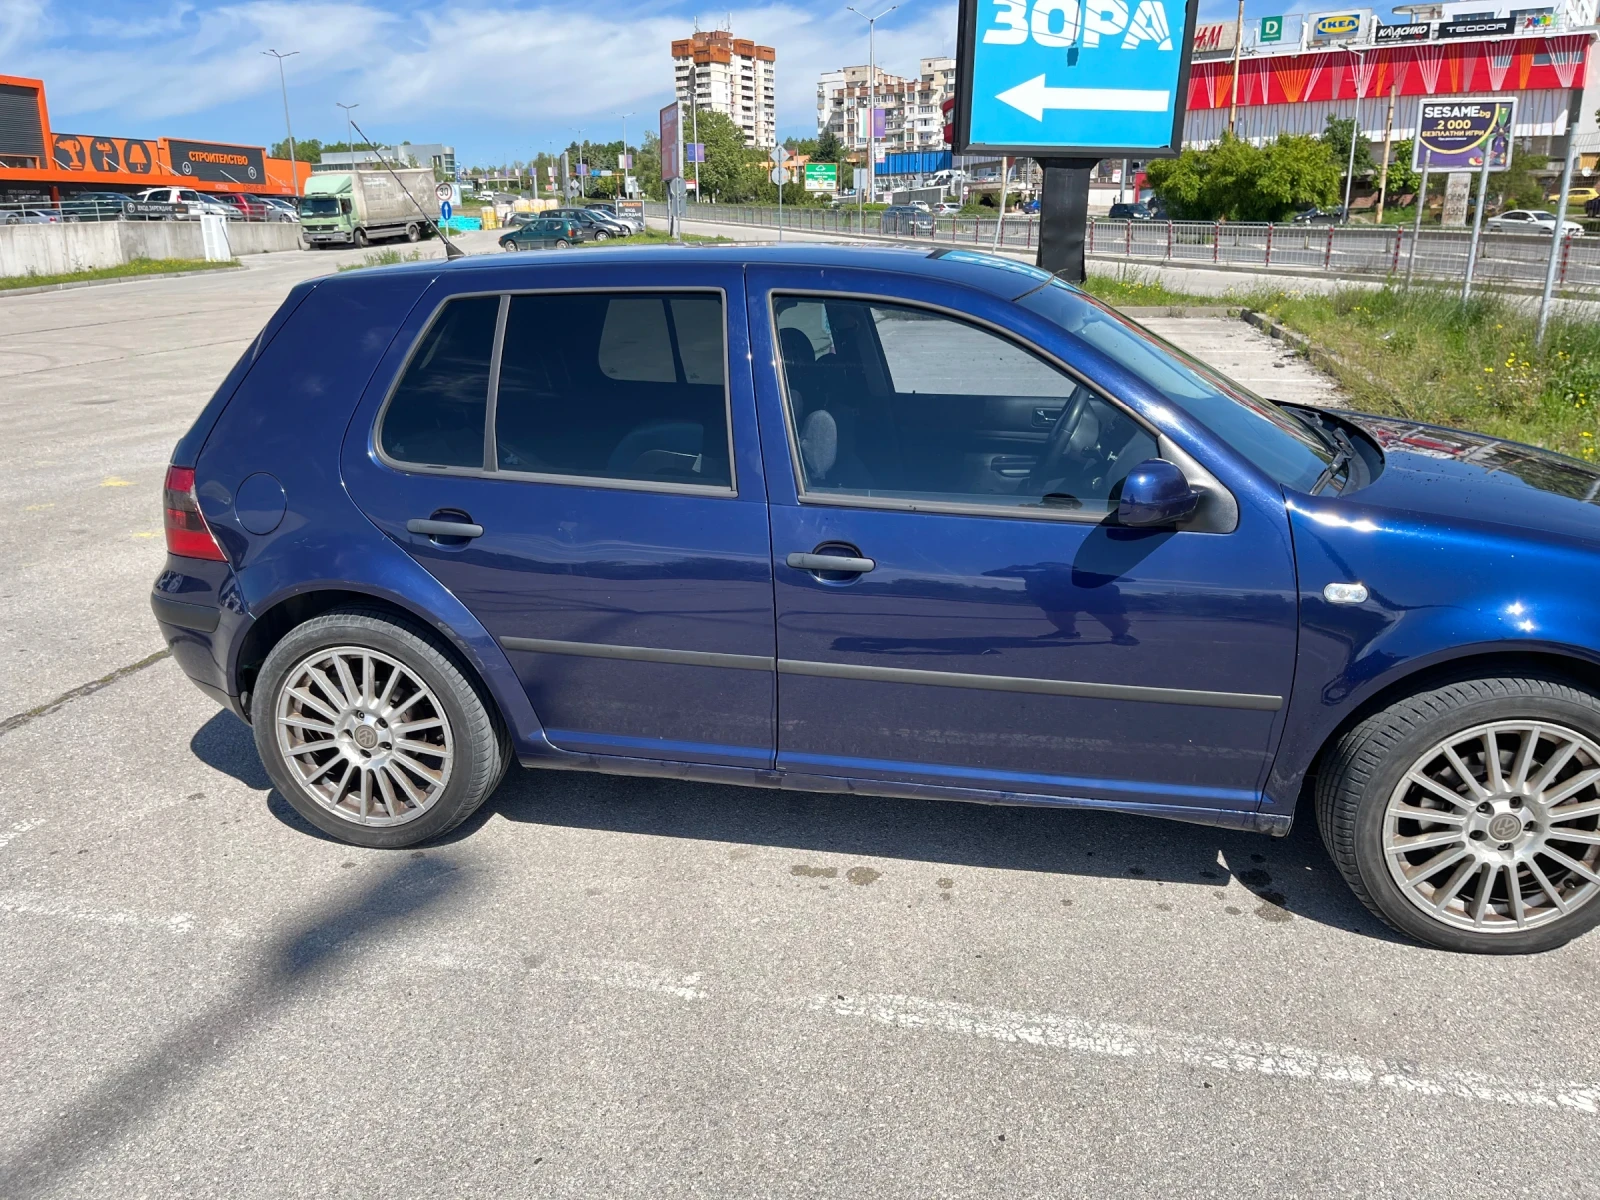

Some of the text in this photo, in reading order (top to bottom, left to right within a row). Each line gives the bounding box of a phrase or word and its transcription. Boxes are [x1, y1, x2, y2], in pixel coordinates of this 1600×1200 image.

[982, 0, 1174, 51] ЗОРА
[1321, 20, 1356, 29] IKEA
[1446, 23, 1507, 33] TEODOR
[188, 151, 249, 166] СТРОИТЕЛСТВО
[439, 187, 449, 197] 30
